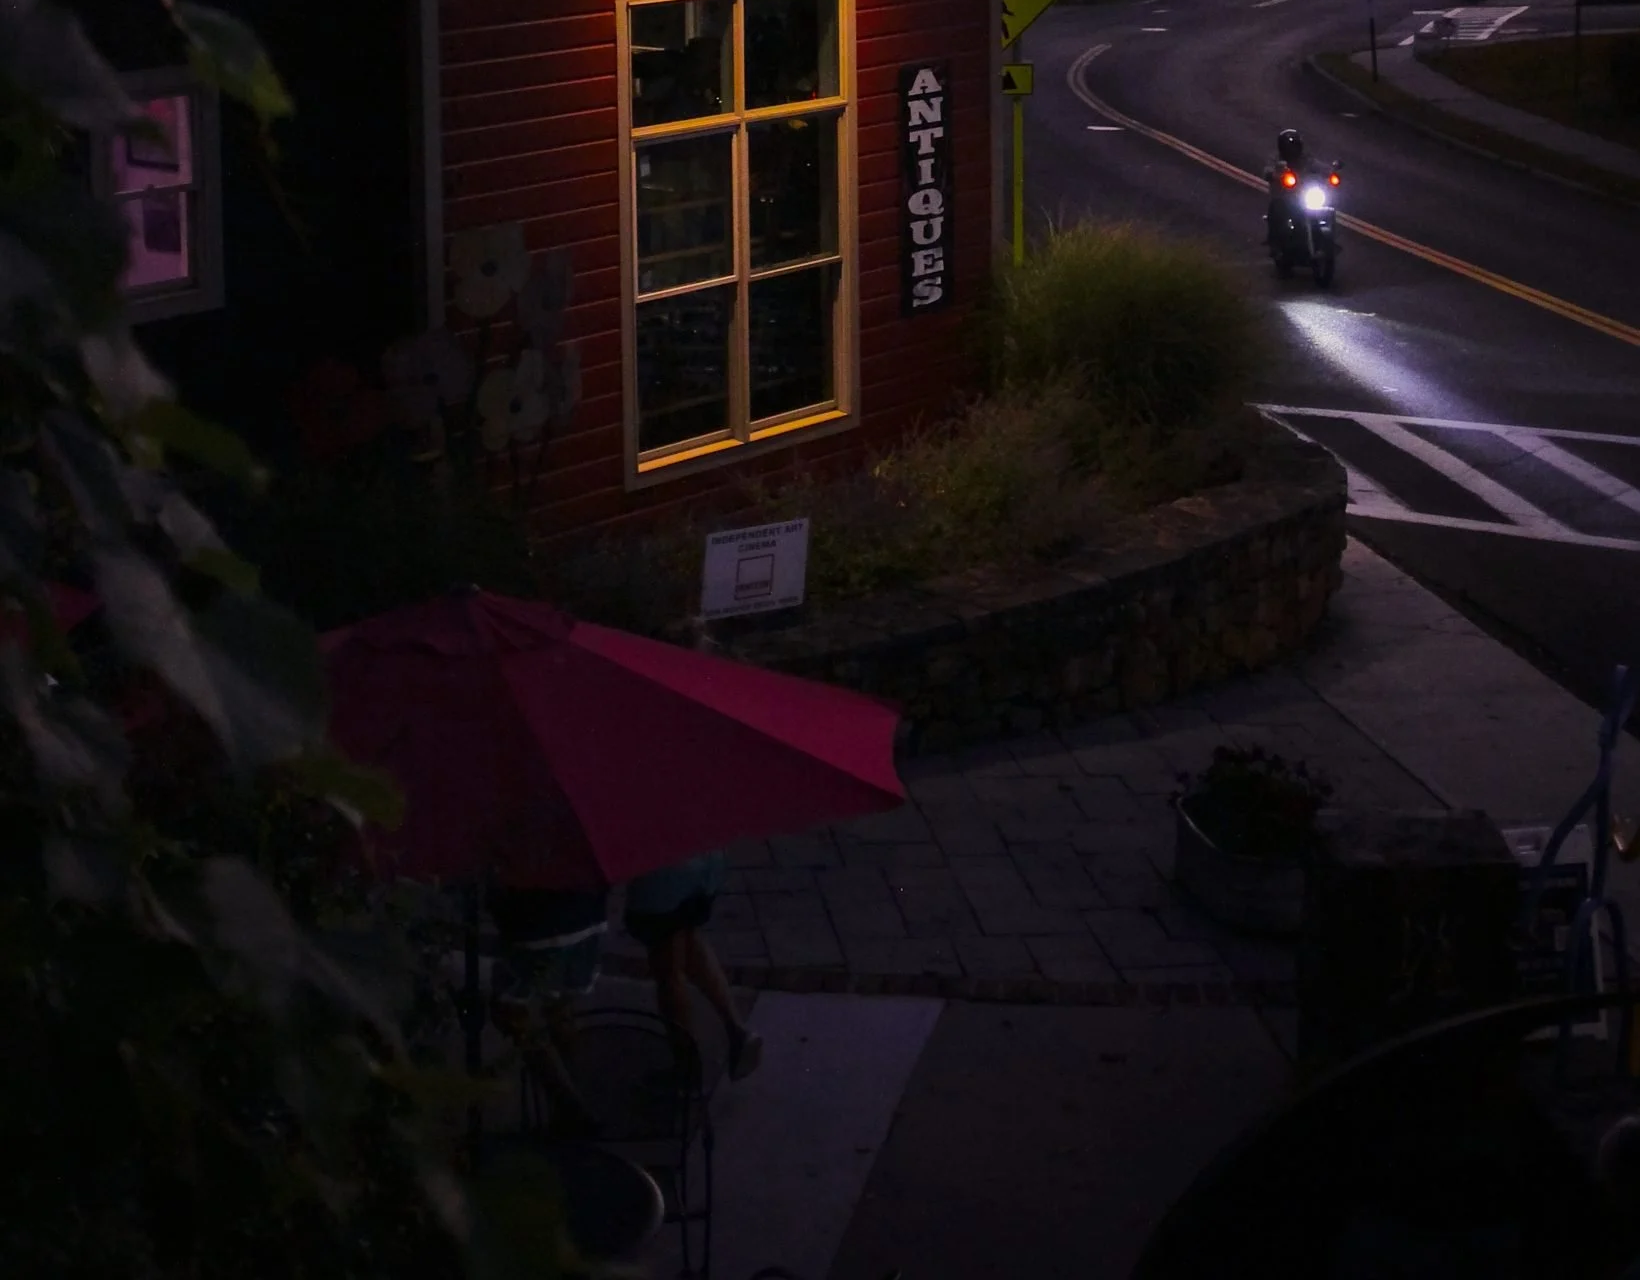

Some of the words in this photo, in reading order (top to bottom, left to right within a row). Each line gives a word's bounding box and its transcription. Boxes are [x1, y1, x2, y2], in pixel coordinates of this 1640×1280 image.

[907, 68, 945, 308] ANTIQUES
[711, 527, 781, 545] INDEPENDENT
[738, 540, 777, 553] CINEMA
